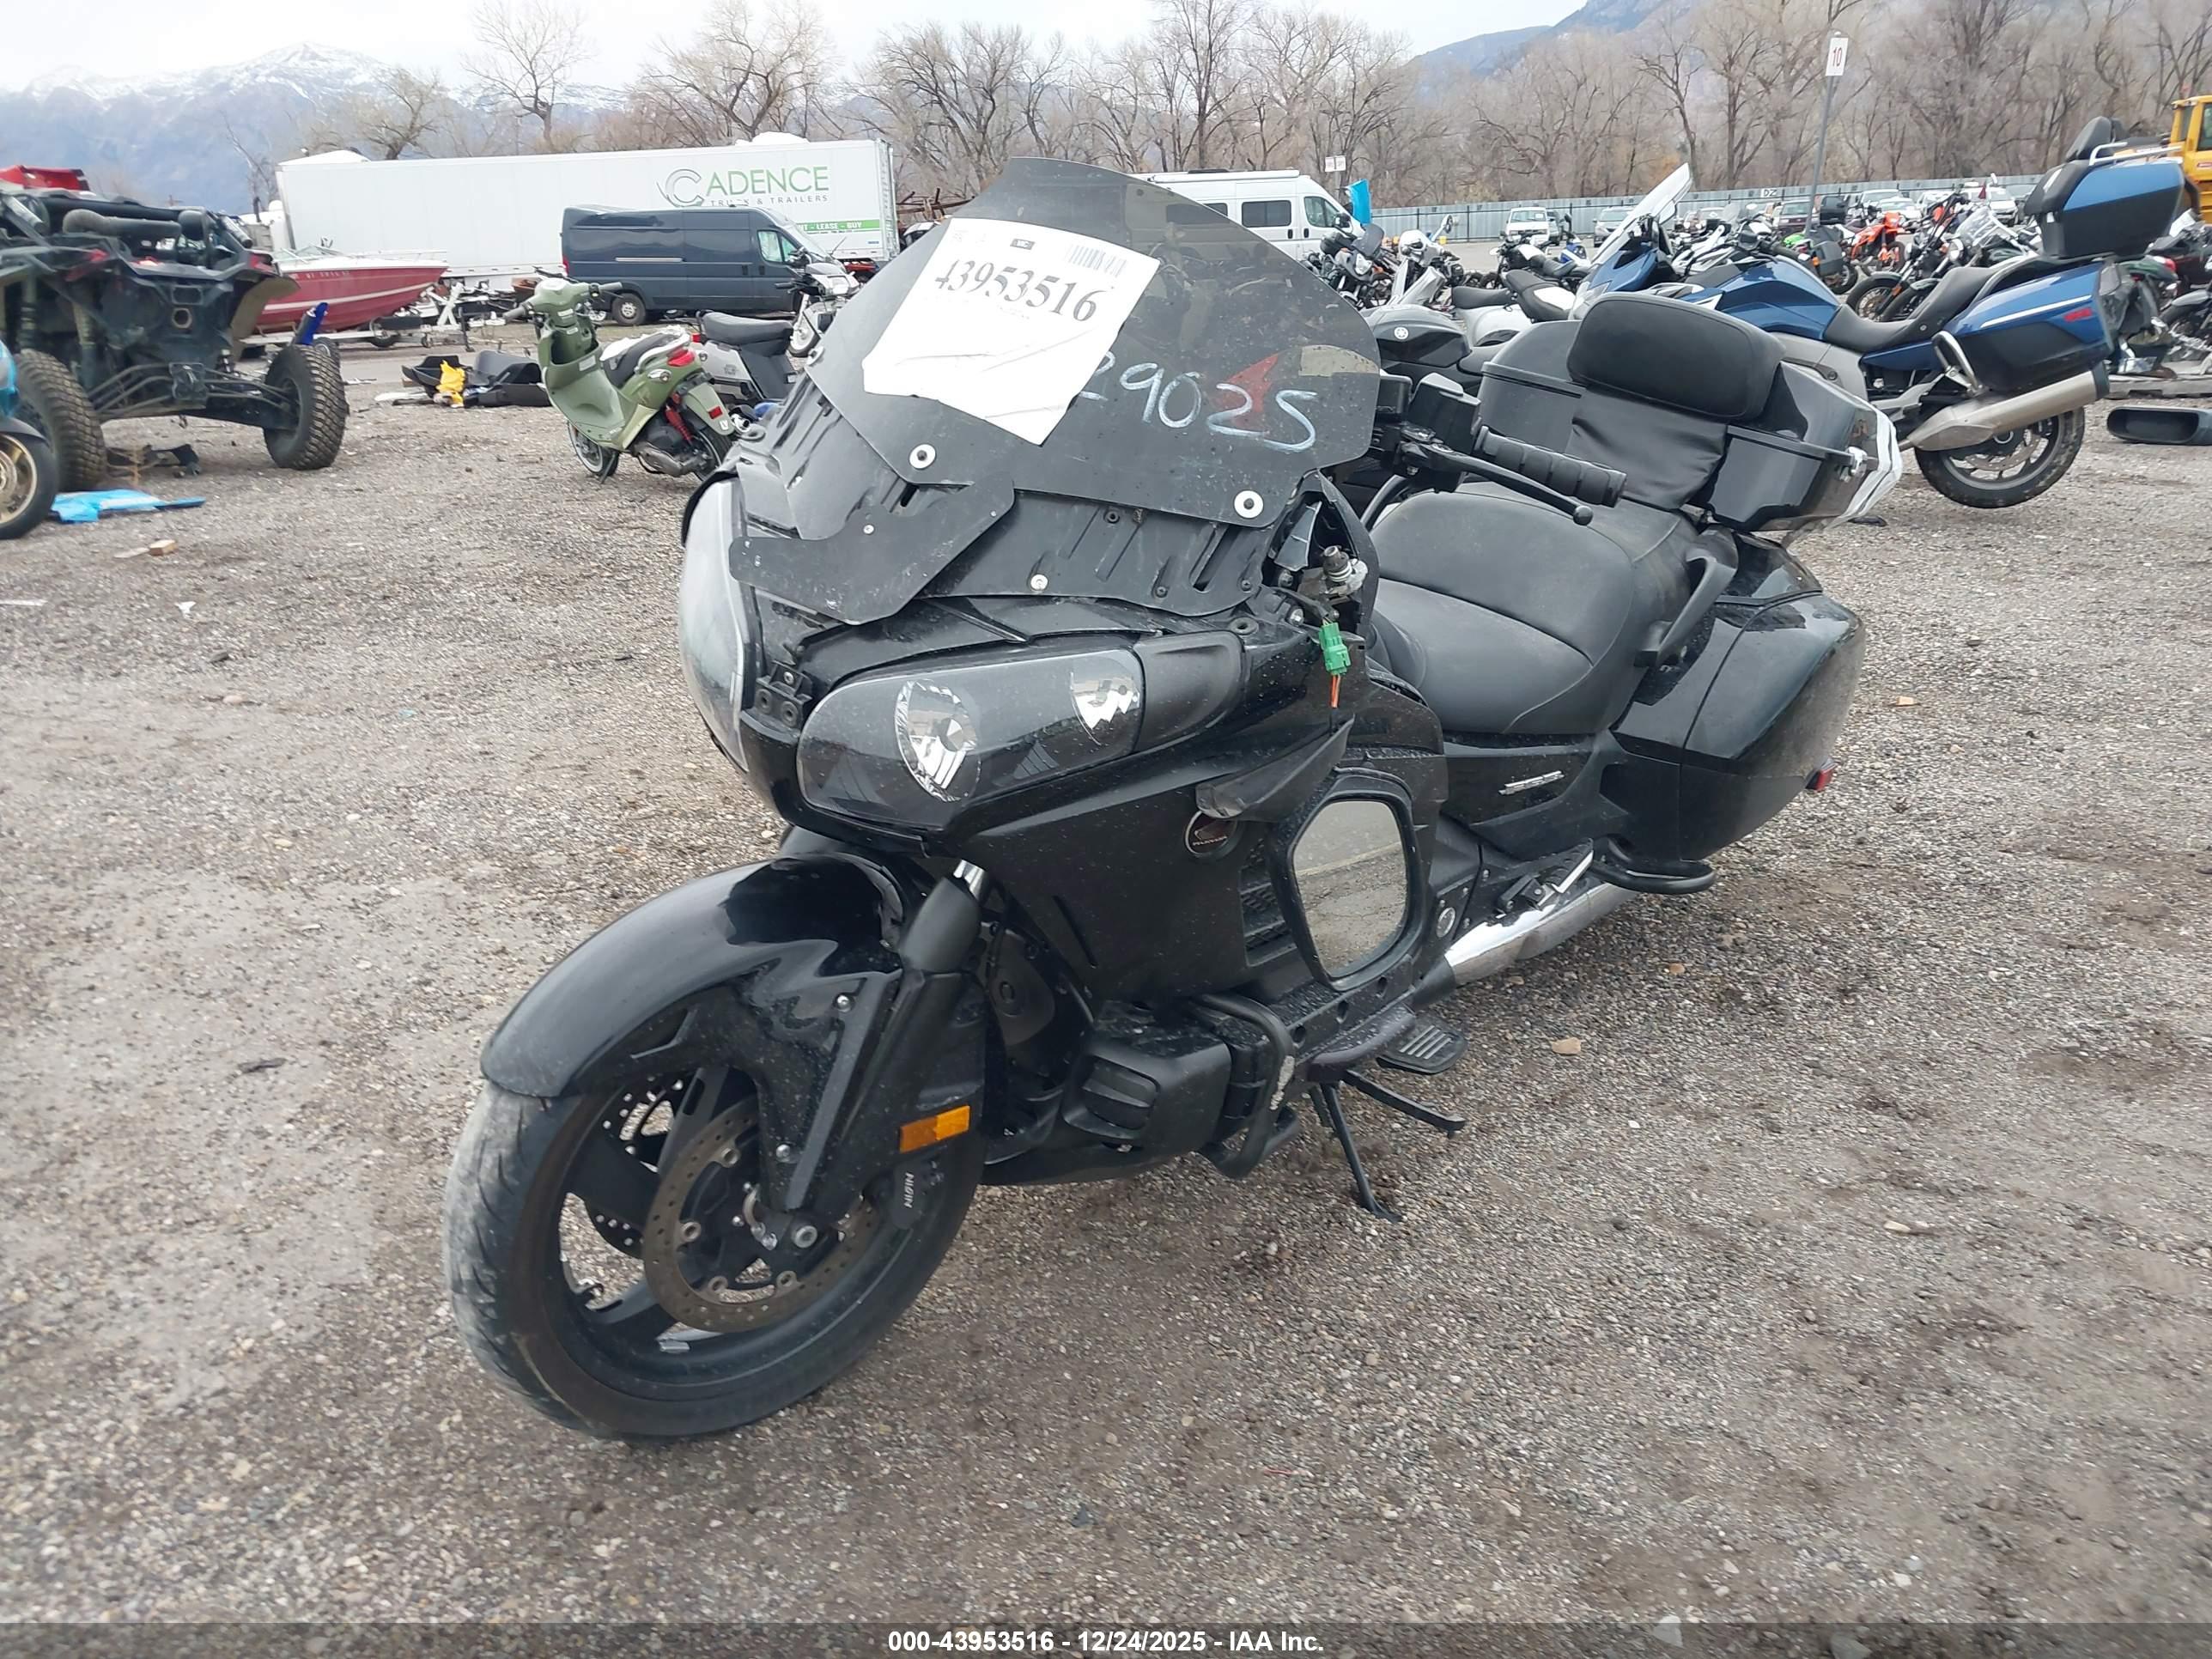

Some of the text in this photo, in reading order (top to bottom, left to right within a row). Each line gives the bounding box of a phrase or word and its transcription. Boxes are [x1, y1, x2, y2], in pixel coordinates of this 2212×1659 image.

[656, 166, 830, 207] CADENCE
[770, 194, 828, 204] TRAILERS
[934, 259, 1113, 321] 43953516
